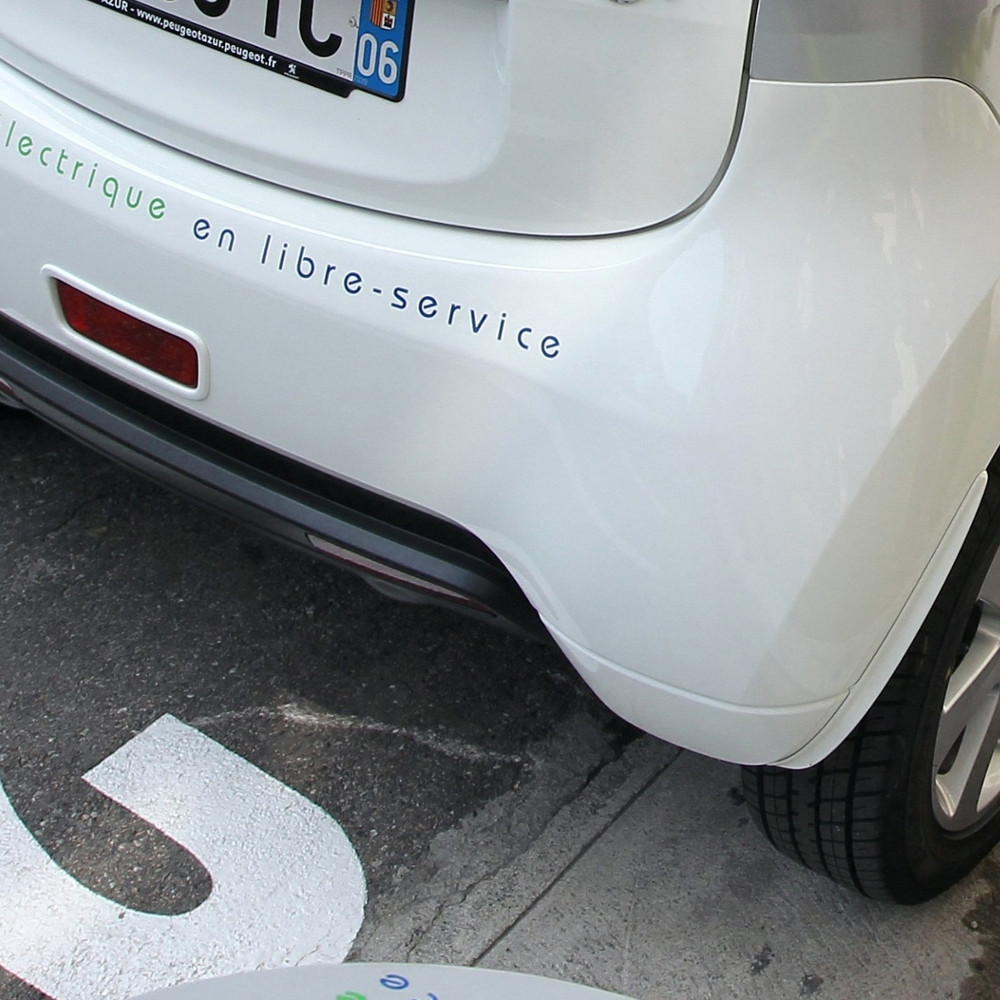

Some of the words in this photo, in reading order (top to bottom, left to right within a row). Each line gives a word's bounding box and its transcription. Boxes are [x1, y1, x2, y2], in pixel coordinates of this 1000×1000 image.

[136, 7, 278, 69] www.peugeotazur.peugeot.fr
[356, 32, 400, 85] 06
[1, 114, 167, 220] lectrique
[193, 216, 236, 253] en
[260, 233, 562, 360] libre-service
